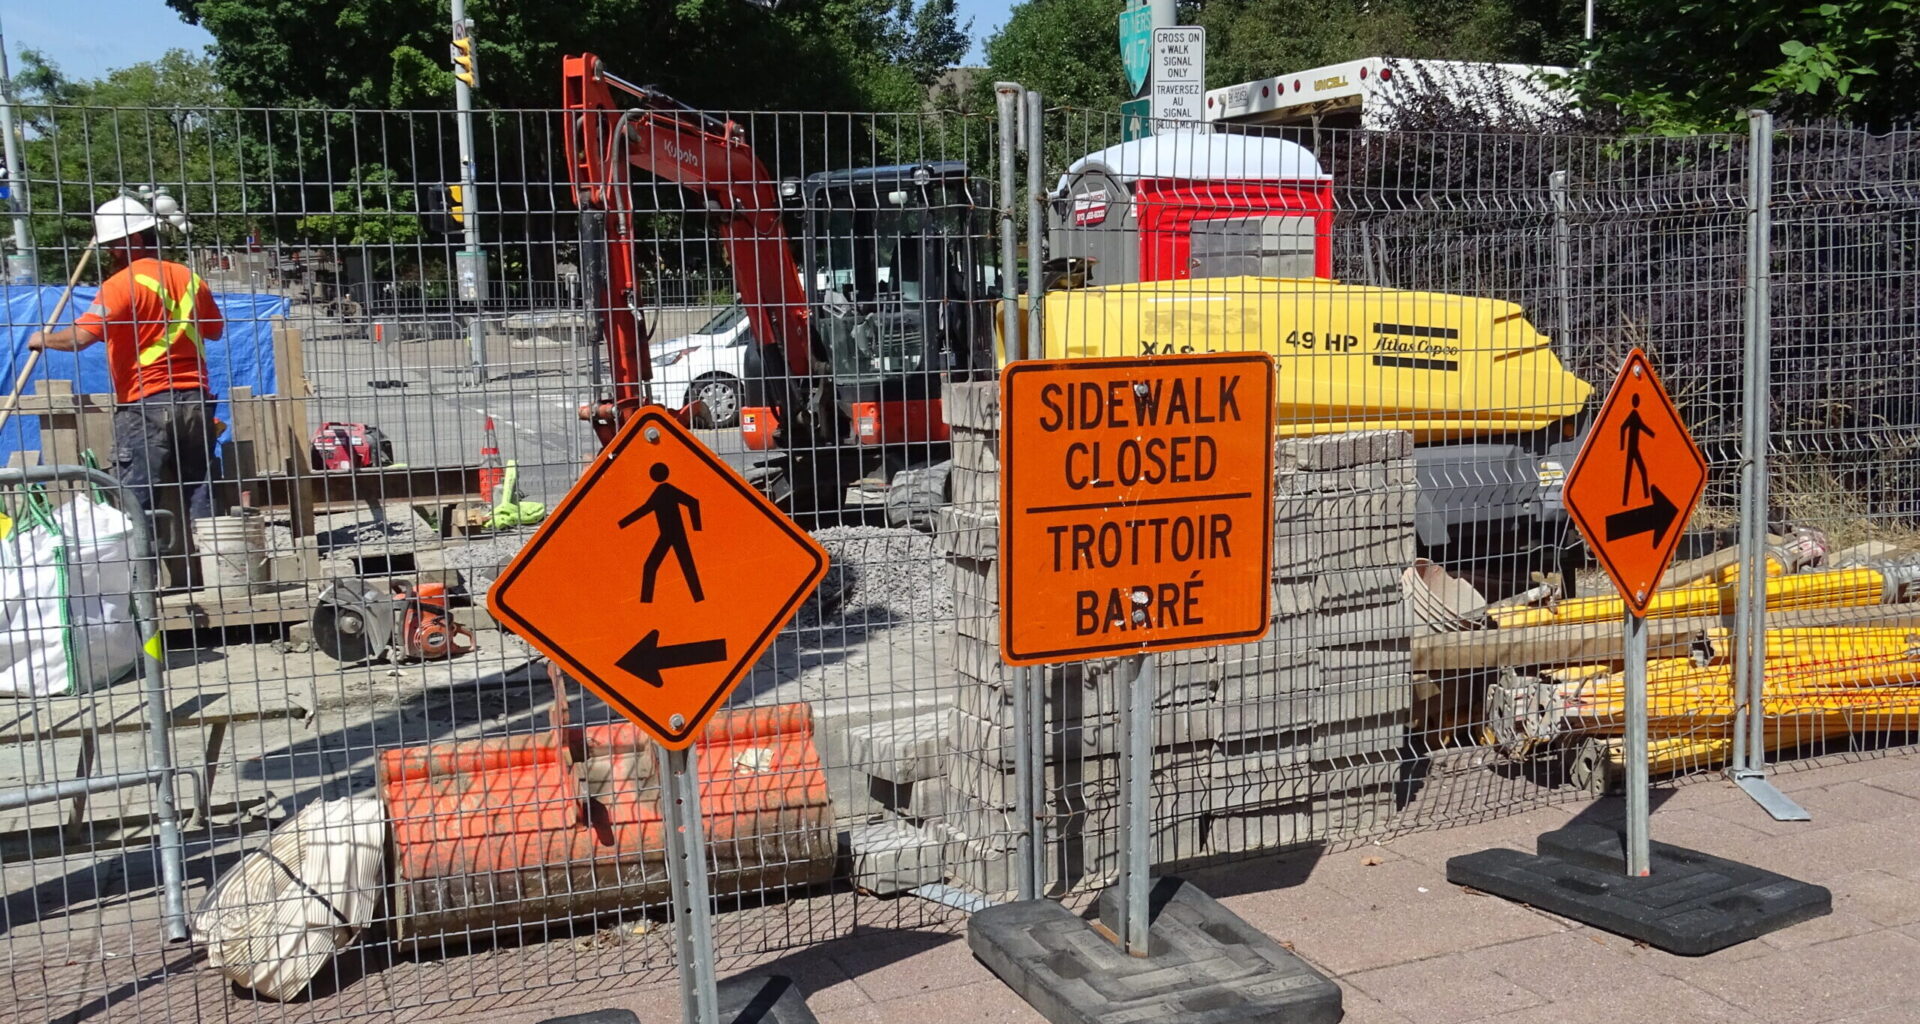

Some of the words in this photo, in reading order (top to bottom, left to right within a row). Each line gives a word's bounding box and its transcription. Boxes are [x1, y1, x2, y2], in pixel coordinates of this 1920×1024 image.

[1157, 33, 1185, 43] CROSS
[1188, 33, 1200, 43] ON
[1167, 44, 1189, 54] WALK
[1124, 38, 1147, 70] 417
[1163, 56, 1192, 66] SIGNAL
[1167, 68, 1188, 78] ONLY
[1157, 85, 1200, 95] TRAVERSEZ
[1172, 96, 1184, 106] AU
[1163, 107, 1192, 118] SIGNAL
[663, 139, 699, 167] Kubota
[1285, 330, 1316, 350] 49
[1325, 333, 1358, 352] HP
[1373, 336, 1414, 352] Atlas
[1417, 340, 1458, 358] Copco
[1039, 375, 1241, 432] SIDEWALK
[1065, 435, 1217, 490] CLOSED
[1047, 513, 1232, 572] TROTTOIR
[1076, 570, 1204, 636] BARRÉ
